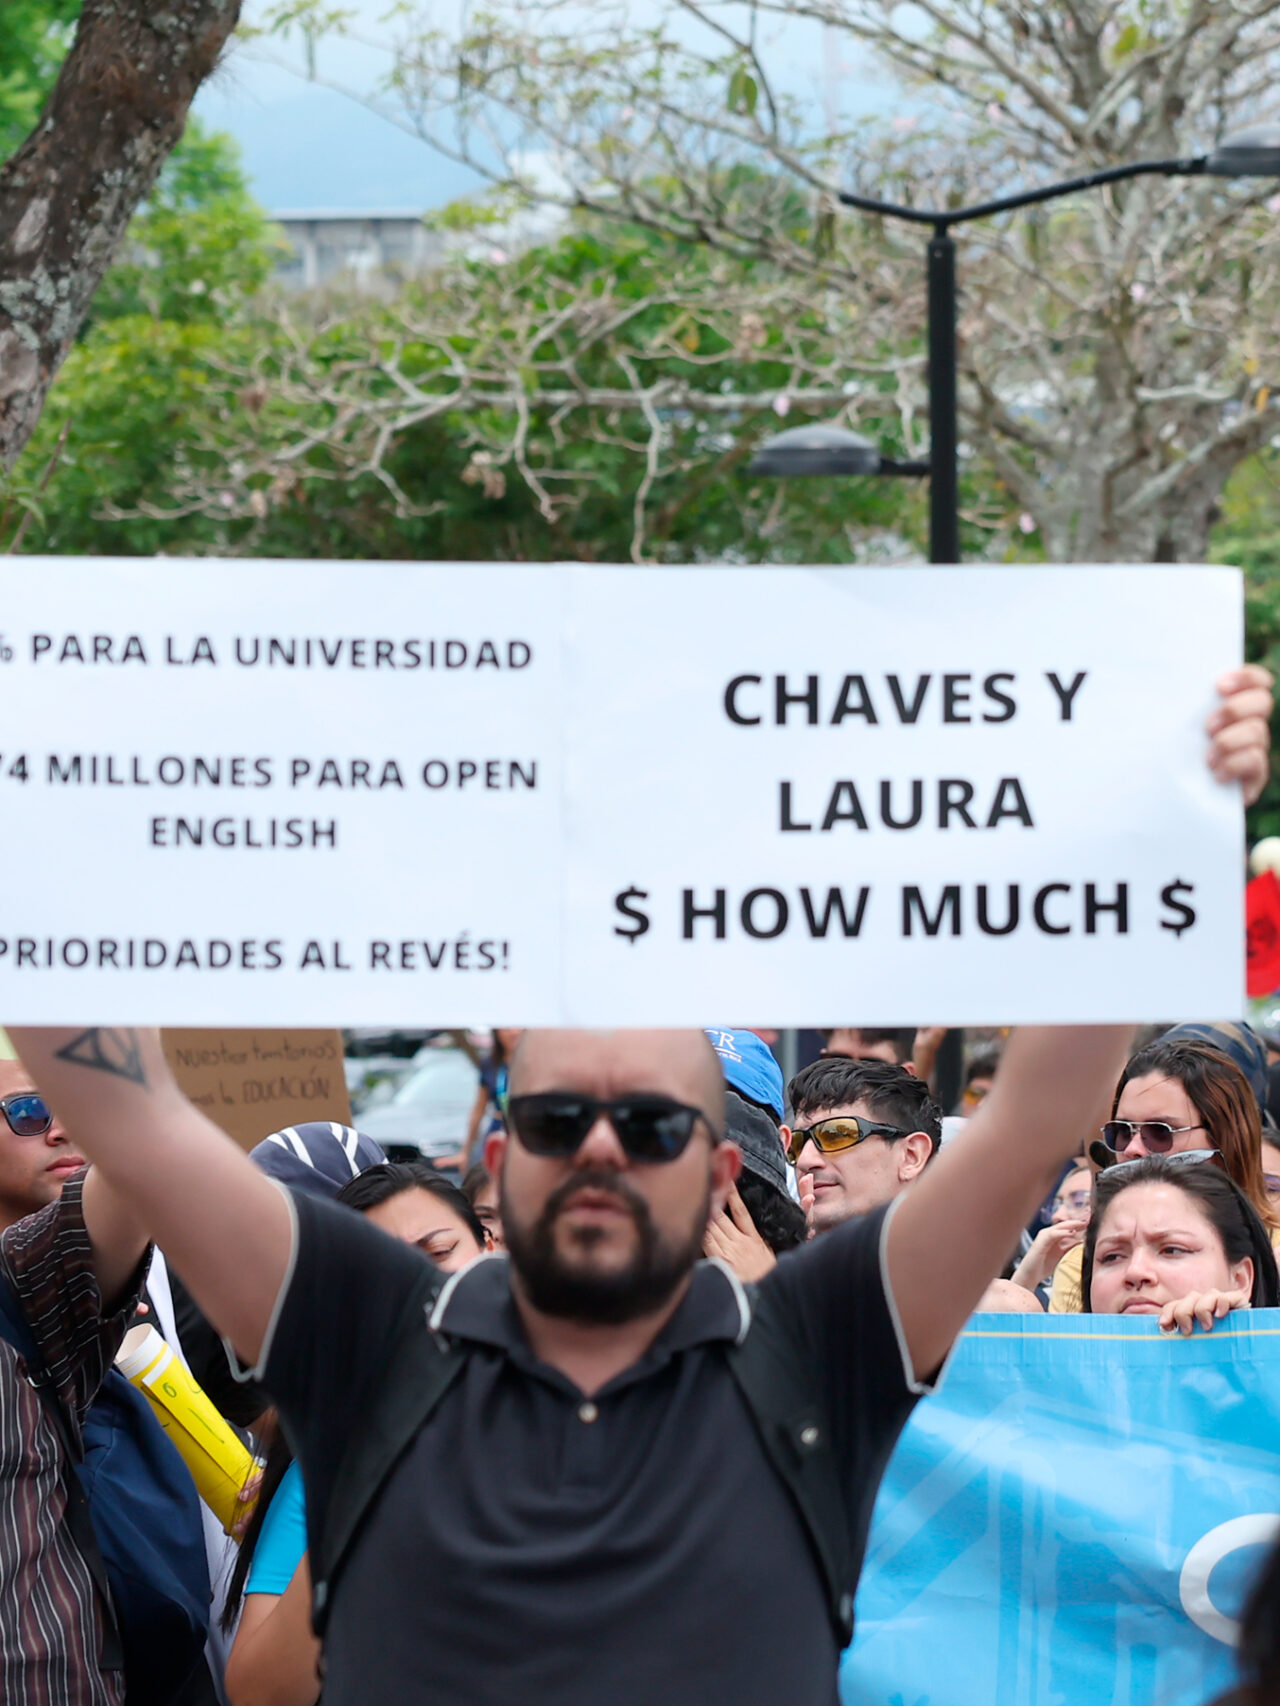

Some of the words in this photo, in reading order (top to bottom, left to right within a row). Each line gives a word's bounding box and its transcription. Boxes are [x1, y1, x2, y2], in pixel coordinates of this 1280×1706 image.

[33, 634, 148, 666] PARA
[167, 636, 217, 666] LA
[236, 638, 533, 671] UNIVERSIDAD
[723, 672, 1018, 728] CHAVES
[1045, 670, 1089, 724] Y
[0, 755, 30, 784] 4
[48, 755, 273, 788] MILLONES
[291, 758, 405, 789] PARA
[422, 760, 538, 790] OPEN
[779, 777, 1036, 834] LAURA
[151, 817, 338, 849] ENGLISH
[614, 885, 652, 945] $
[682, 885, 873, 941] HOW
[901, 882, 1130, 938] MUCH
[1159, 878, 1199, 939] $
[300, 940, 352, 971] AL
[370, 931, 510, 971] REVÉS!
